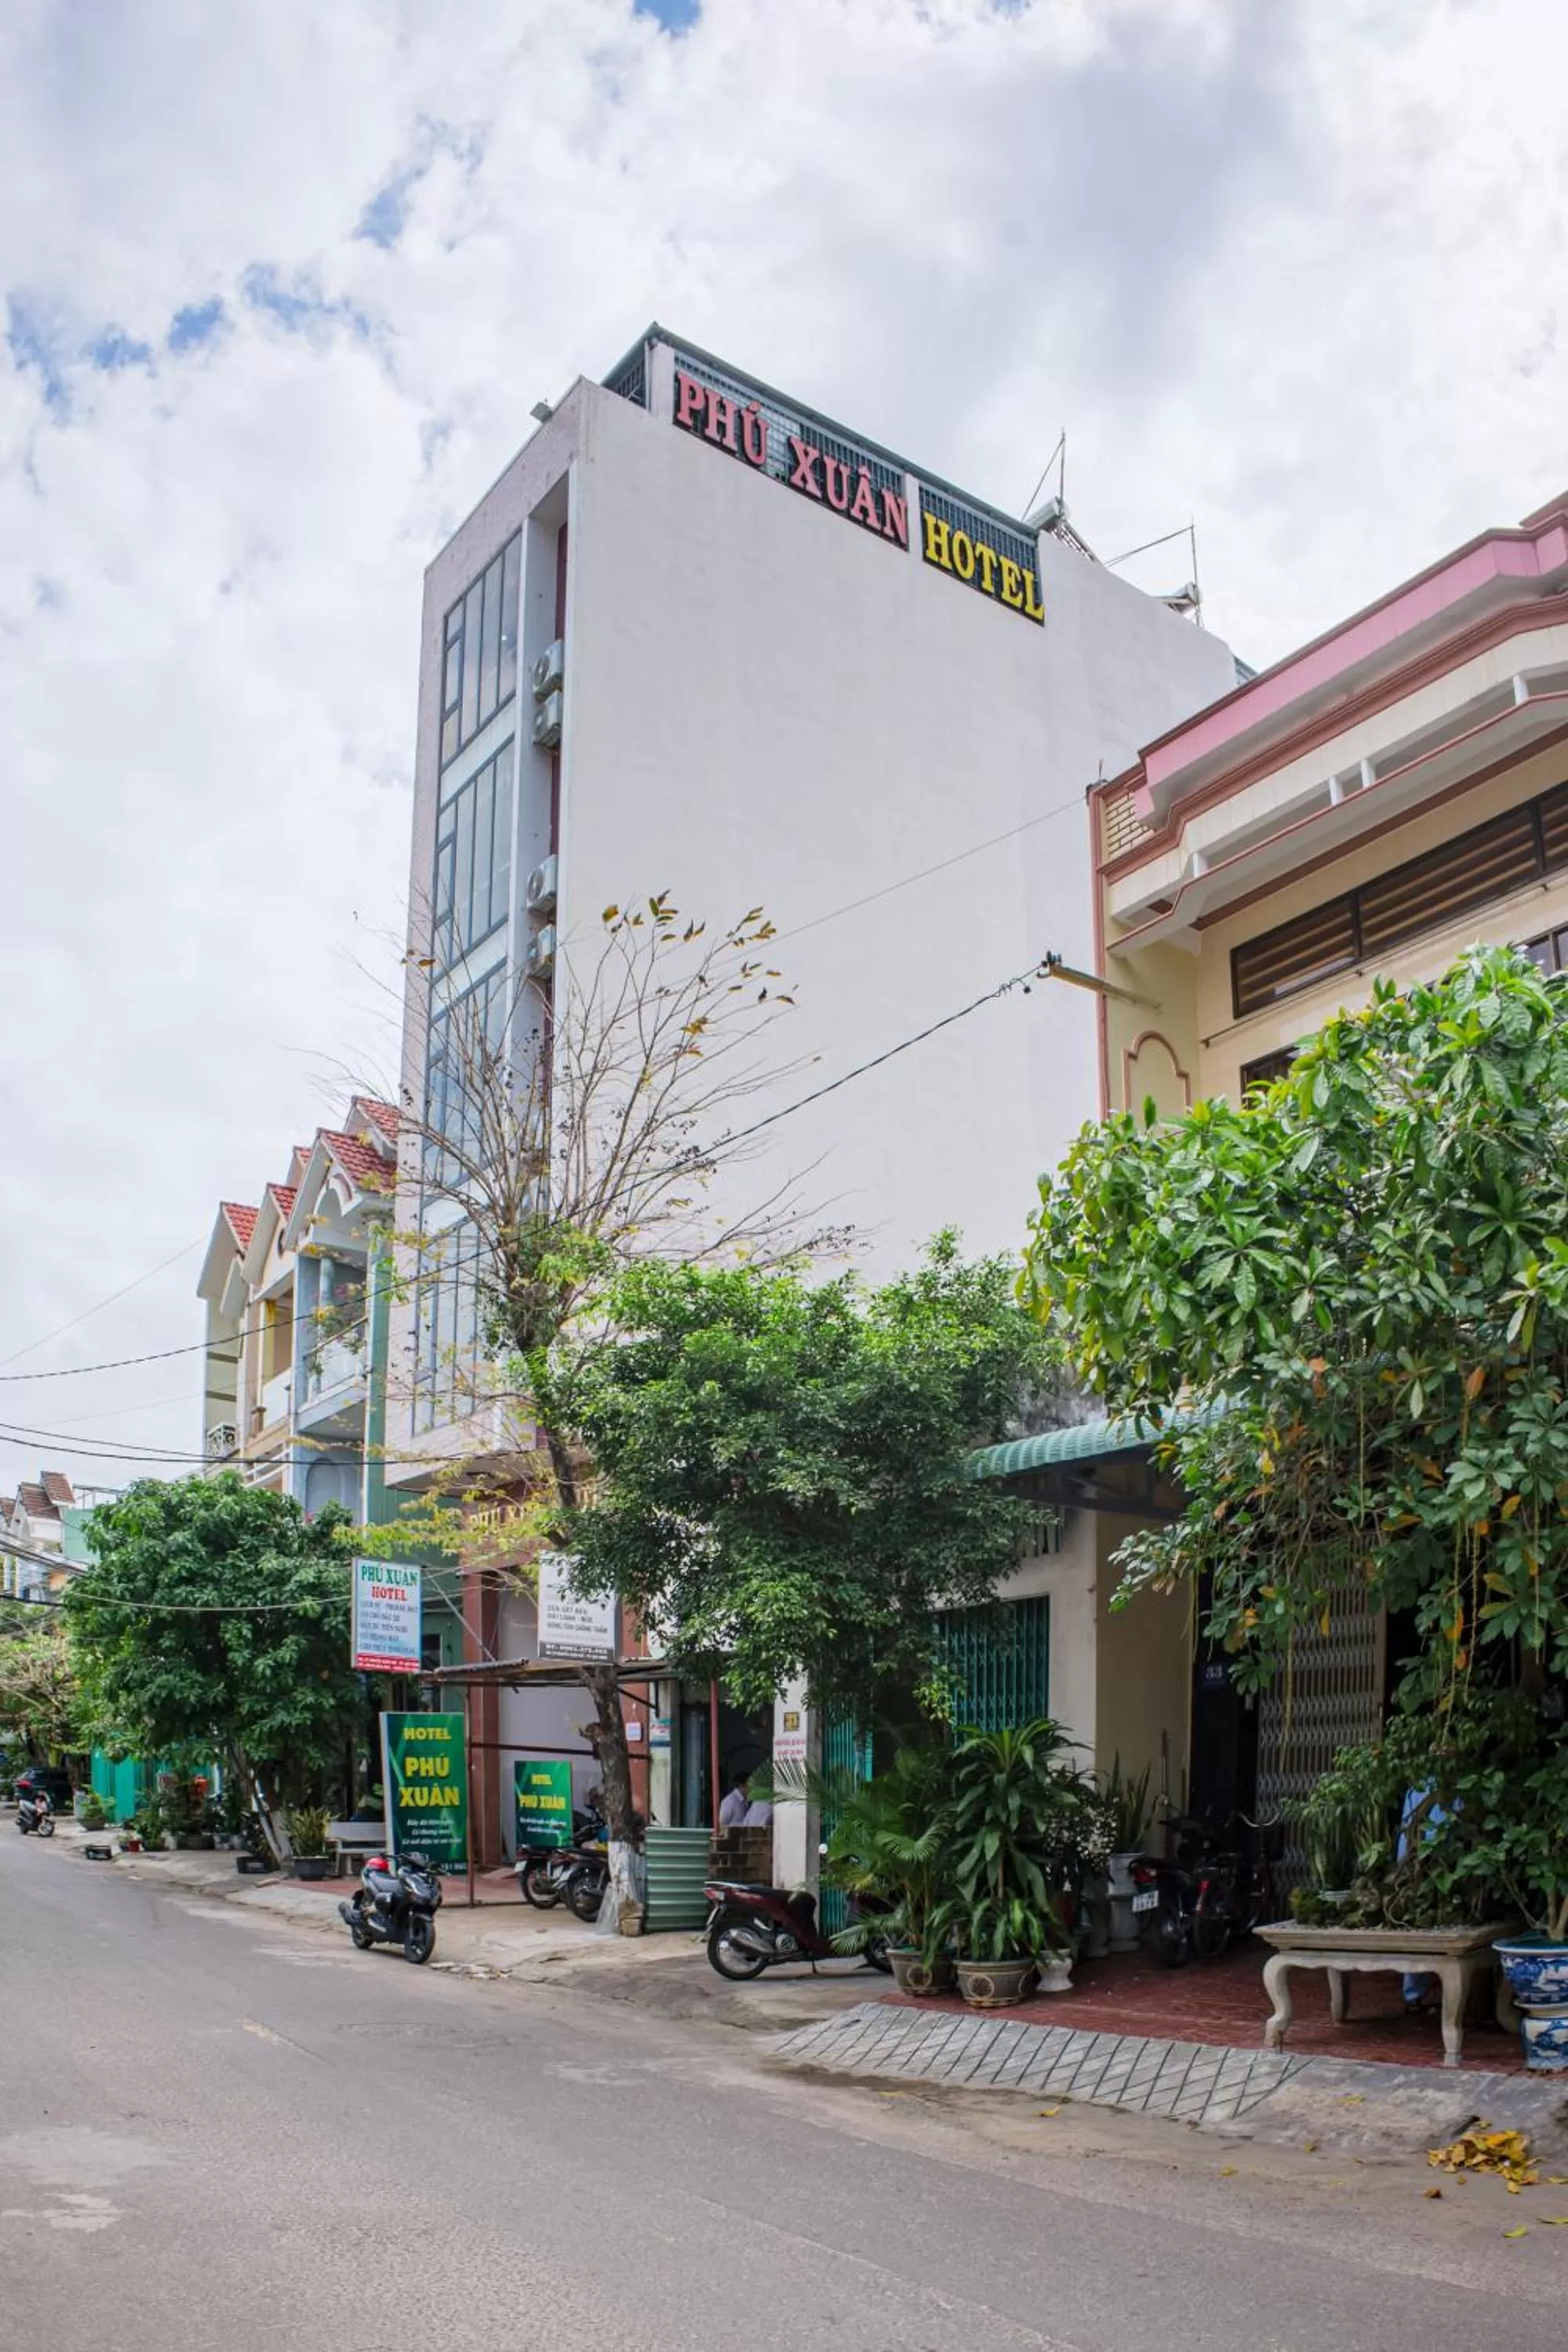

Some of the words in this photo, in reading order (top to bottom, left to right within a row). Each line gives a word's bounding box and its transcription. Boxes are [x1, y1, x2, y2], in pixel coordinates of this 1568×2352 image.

[676, 372, 770, 466] PHÚ
[789, 435, 909, 545] XUÂN
[923, 511, 1045, 622] HOTEL
[372, 1586, 408, 1602] HOTEL
[403, 1727, 452, 1740] HOTEL
[405, 1755, 449, 1777] PHÚ
[399, 1784, 459, 1806] XUÂN
